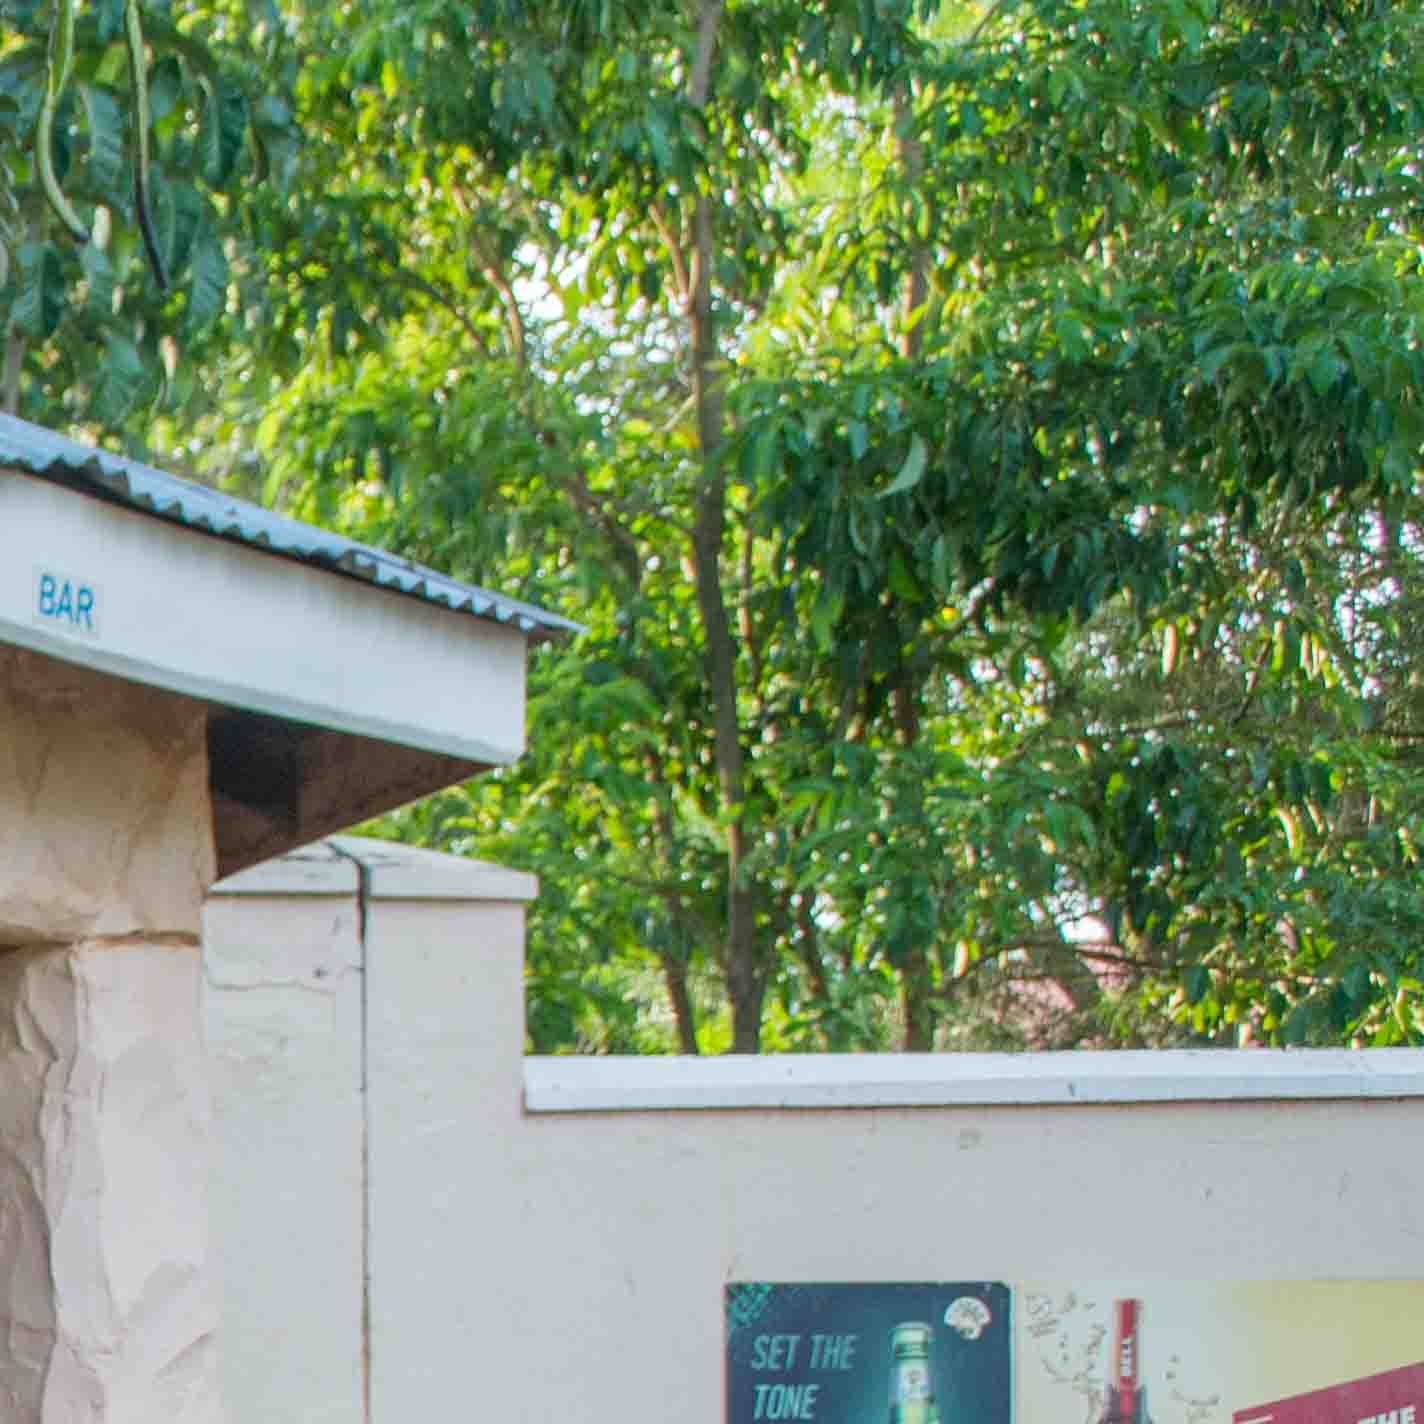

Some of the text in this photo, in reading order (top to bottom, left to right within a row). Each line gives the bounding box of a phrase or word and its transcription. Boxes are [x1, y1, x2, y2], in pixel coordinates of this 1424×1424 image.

[39, 573, 95, 628] BAR
[750, 1333, 858, 1370] SET THE
[753, 1383, 820, 1420] TONE
